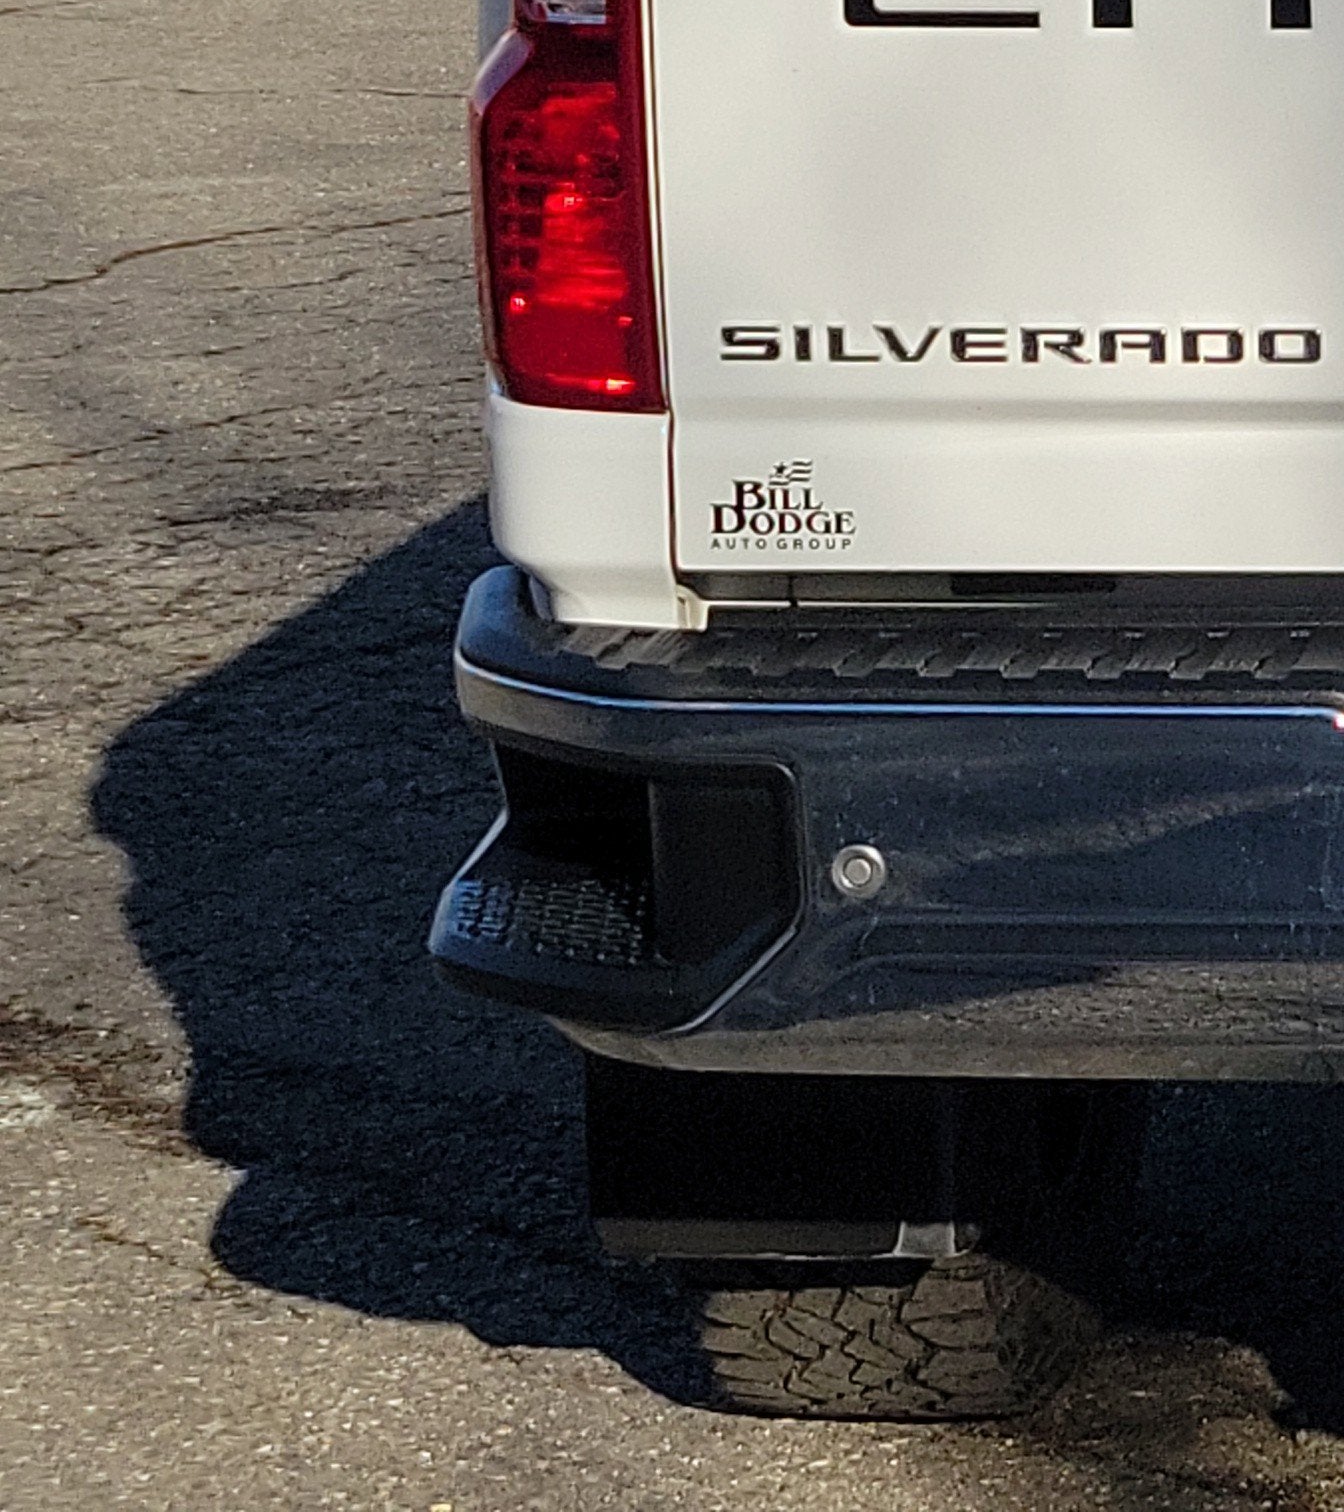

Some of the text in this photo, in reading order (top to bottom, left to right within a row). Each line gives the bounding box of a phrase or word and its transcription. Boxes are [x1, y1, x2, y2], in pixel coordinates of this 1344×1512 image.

[720, 325, 1322, 364] SILVERADO
[732, 478, 824, 510] BILL
[710, 502, 857, 535] DODGE
[710, 538, 852, 550] AUTO GROUP
